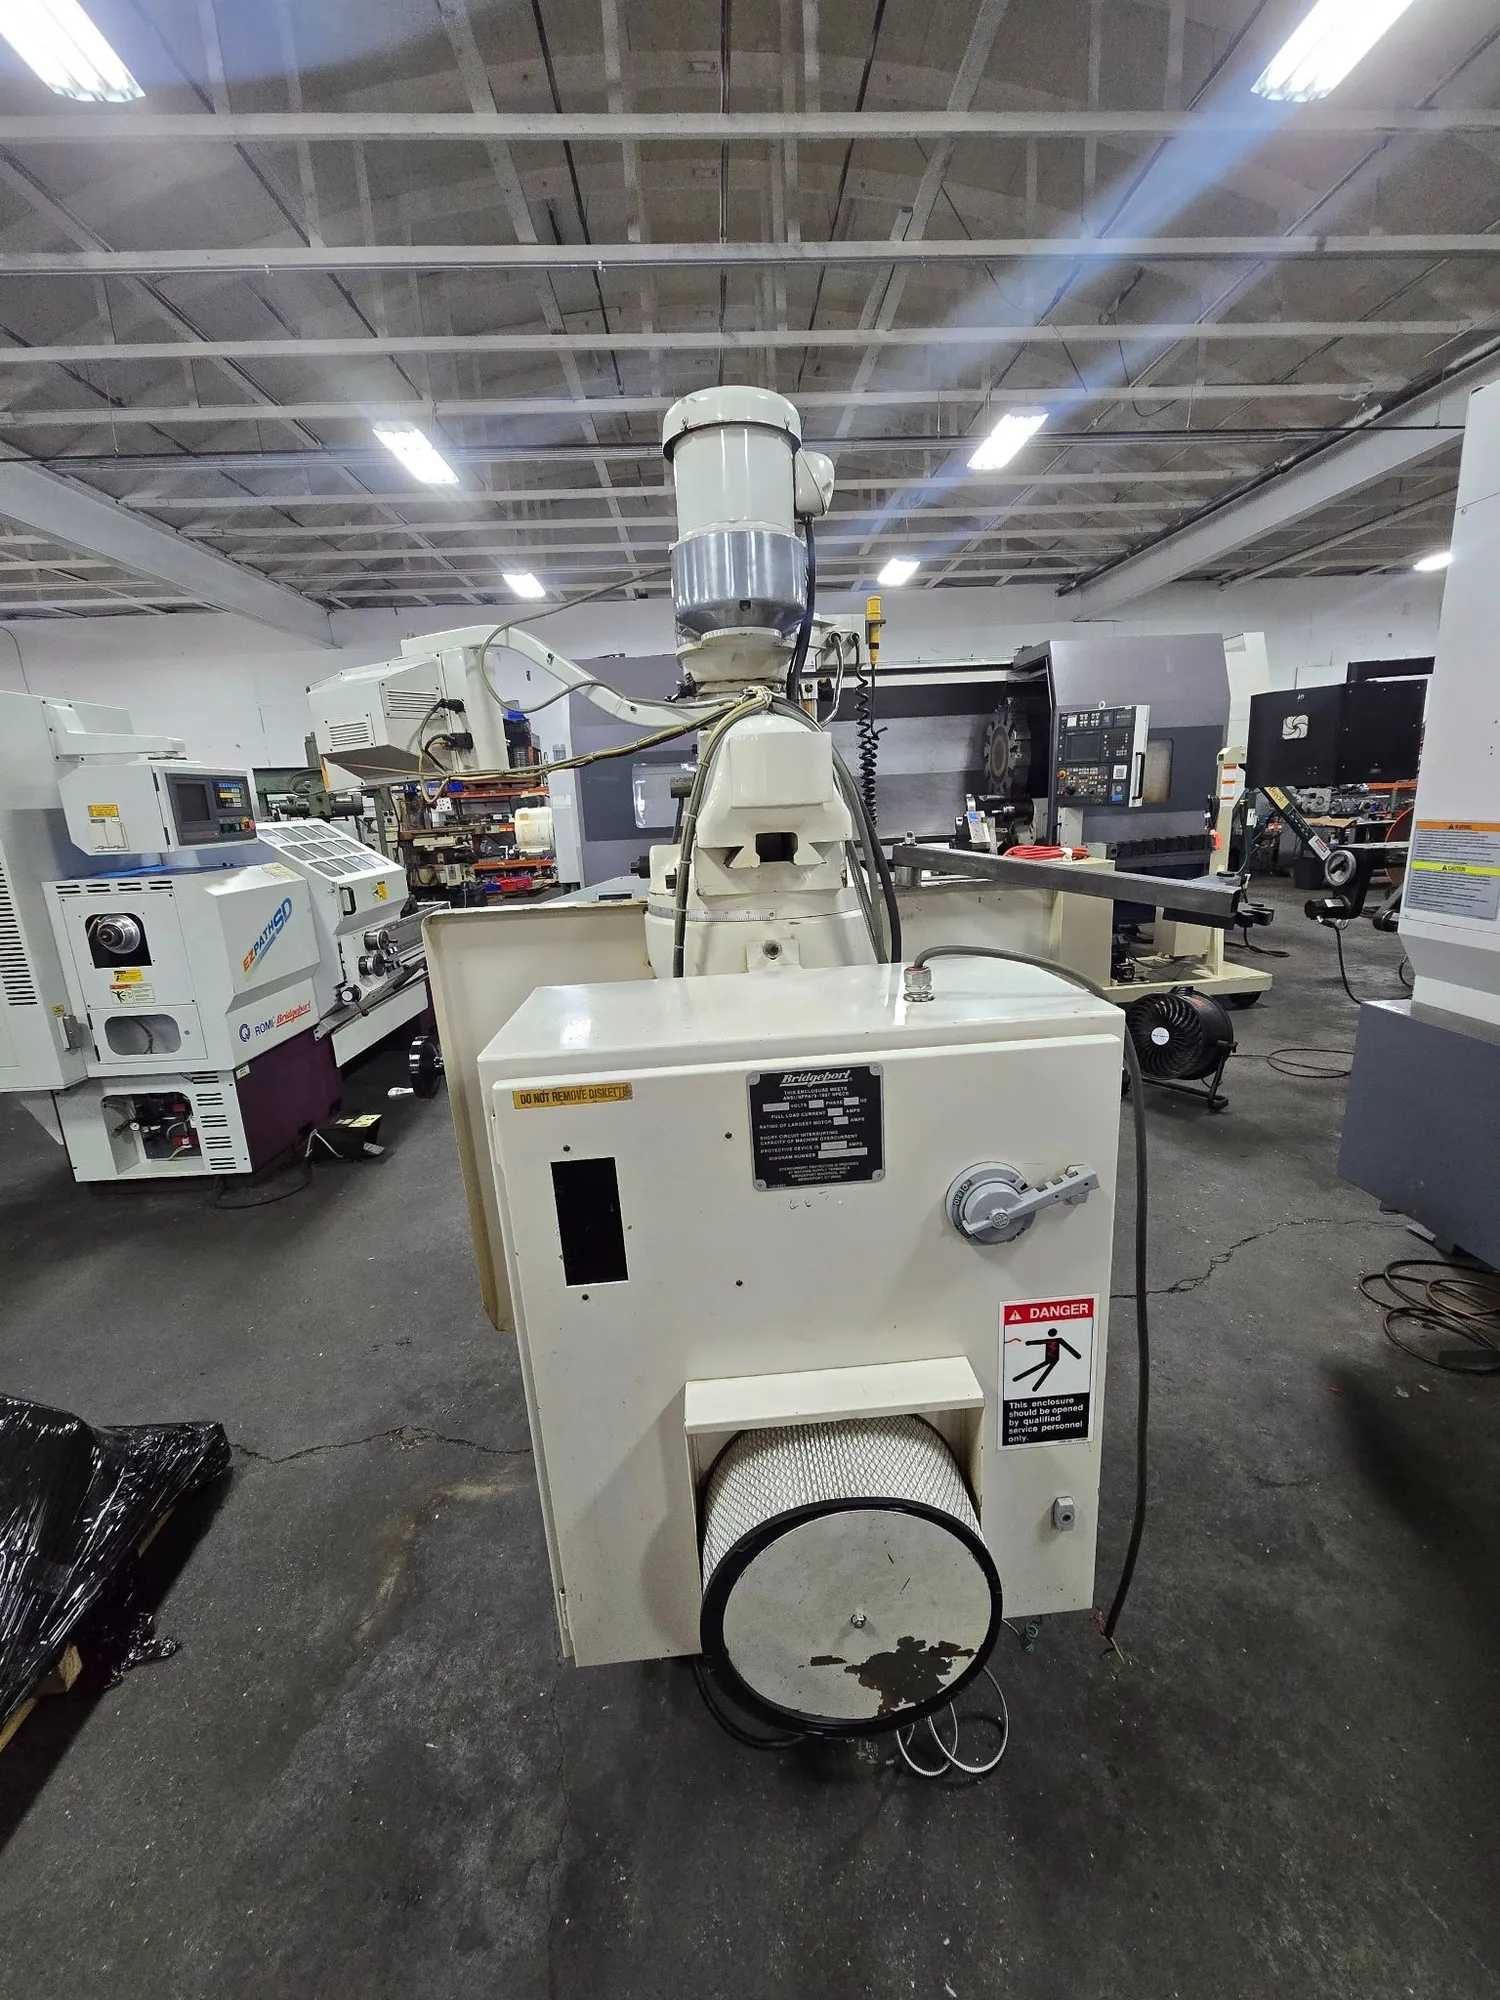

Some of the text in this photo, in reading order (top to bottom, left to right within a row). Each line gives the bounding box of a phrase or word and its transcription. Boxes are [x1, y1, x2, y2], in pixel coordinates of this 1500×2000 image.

[276, 1000, 311, 1026] Bridgeport
[780, 1070, 851, 1087] Bridgeport
[520, 1093, 532, 1105] DO
[533, 1091, 550, 1103] NOT
[551, 1088, 587, 1102] REMOVE
[1029, 1303, 1089, 1319] DANGER
[1009, 1397, 1075, 1409] This enclosure
[1008, 1404, 1084, 1418] should be opened
[1008, 1415, 1061, 1427] by qualified
[1008, 1421, 1083, 1434] service personnel
[1008, 1434, 1029, 1443] only.
